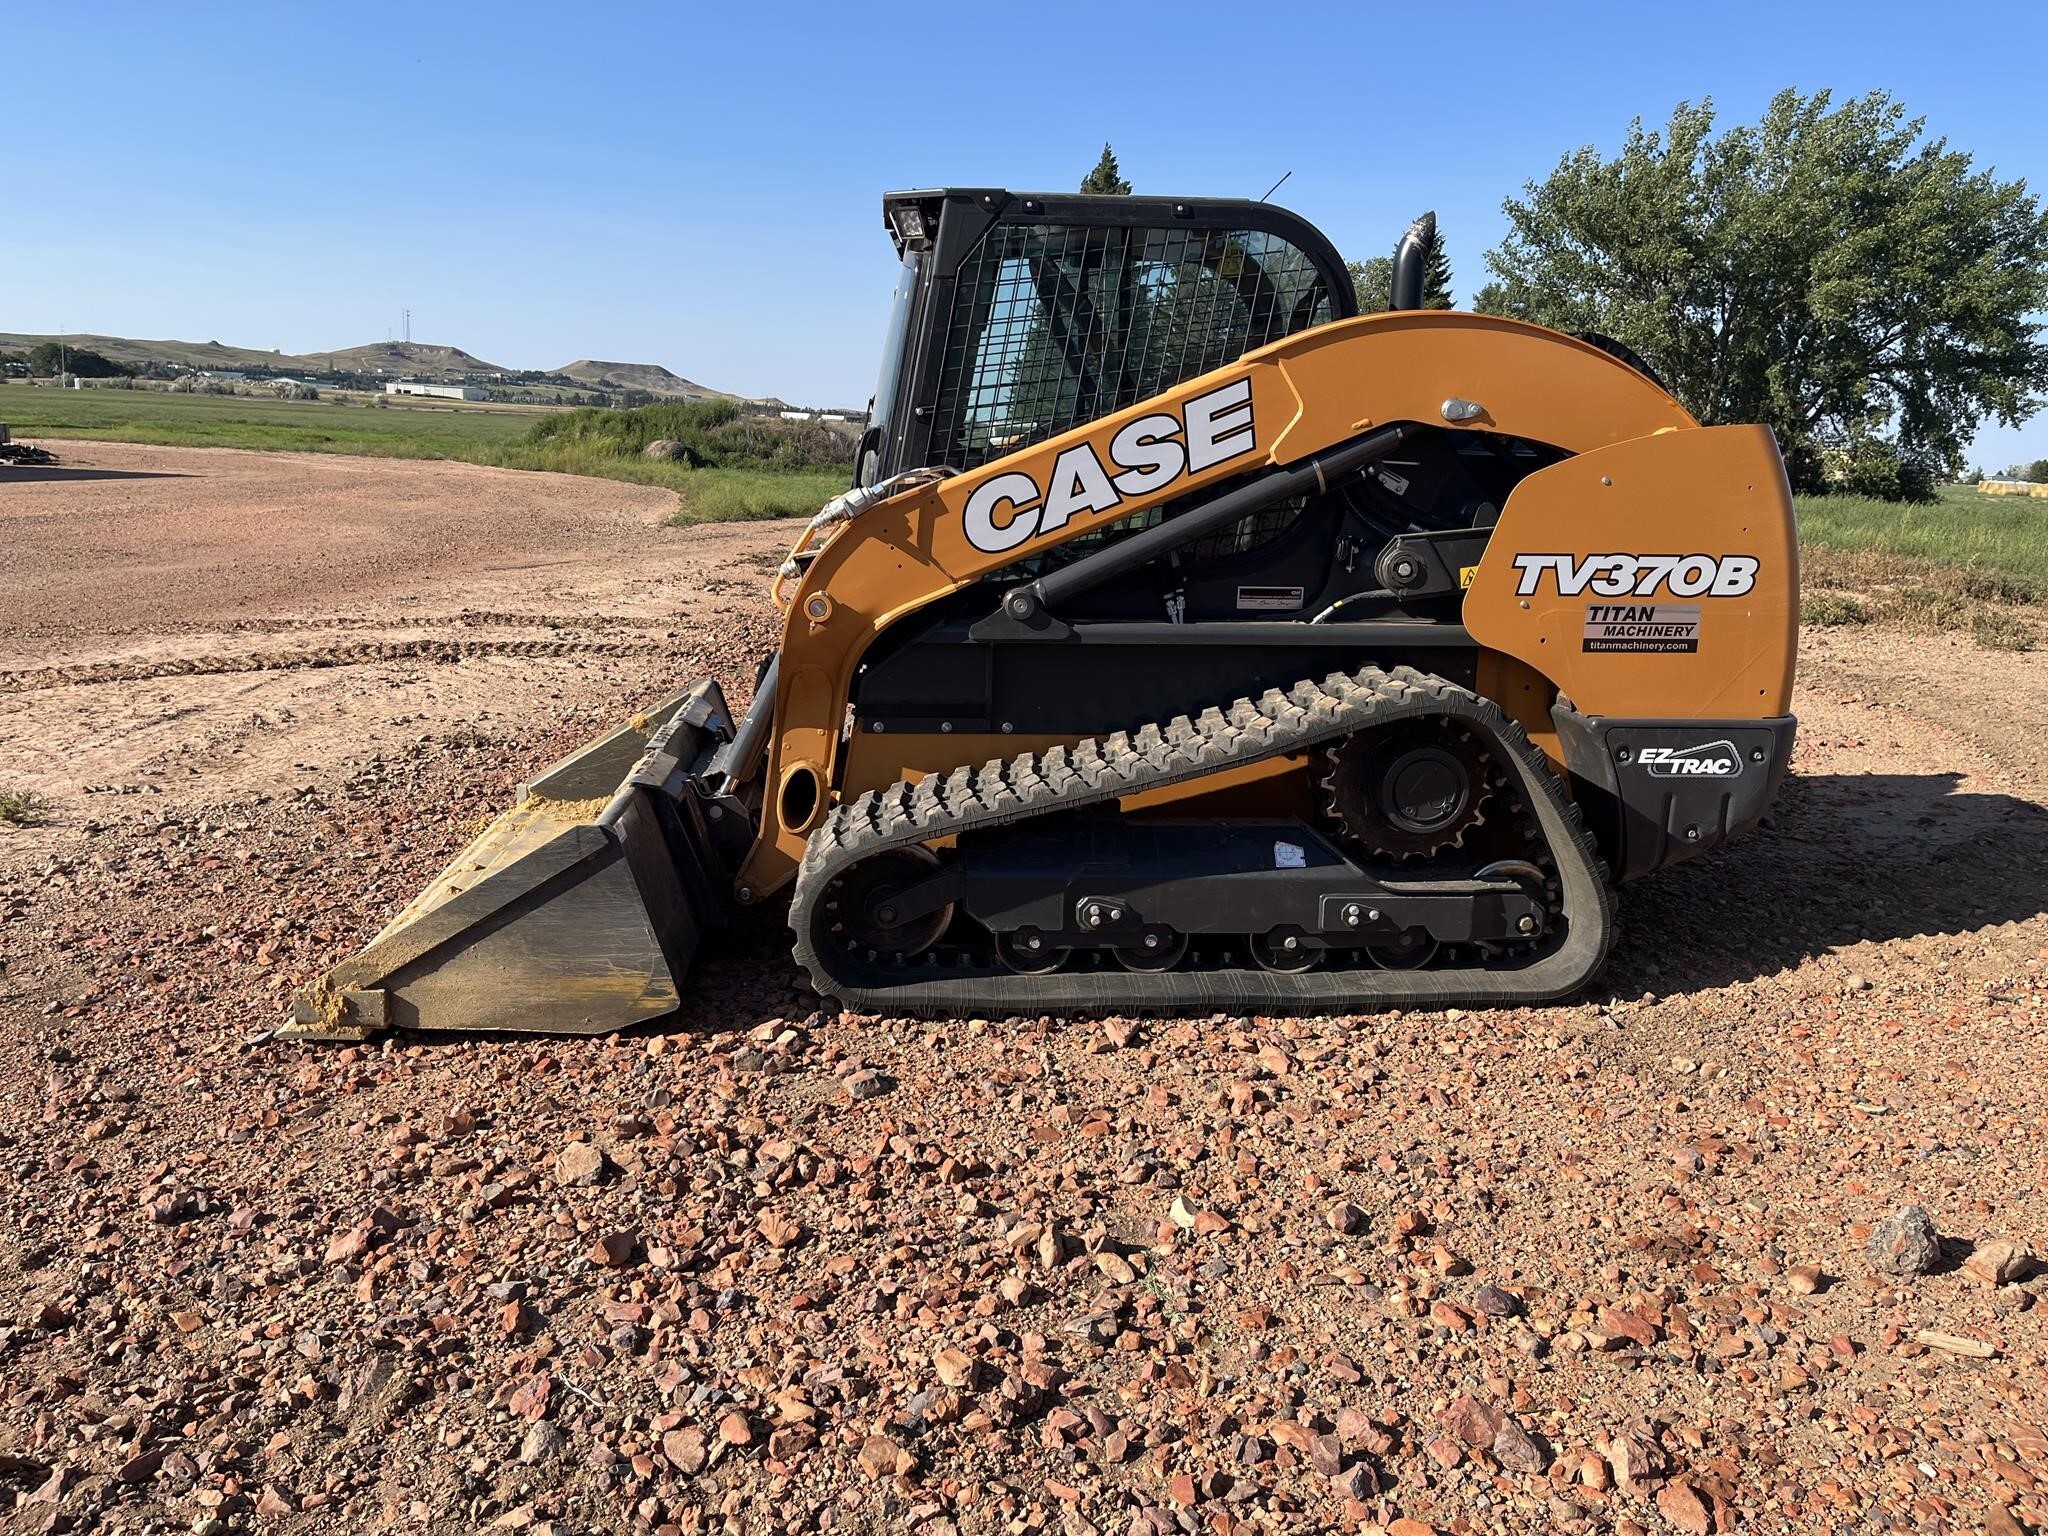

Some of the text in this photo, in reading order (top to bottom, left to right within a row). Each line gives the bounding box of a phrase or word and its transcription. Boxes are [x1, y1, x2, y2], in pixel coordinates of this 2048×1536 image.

[963, 376, 1256, 554] CASE
[1512, 553, 1760, 597] TV370B
[1589, 606, 1655, 622] TITAN
[1603, 625, 1695, 637] MACHINERY
[1590, 641, 1688, 651] titanmachinery.com
[1638, 748, 1674, 764] EZ
[1669, 758, 1732, 774] TRAC
